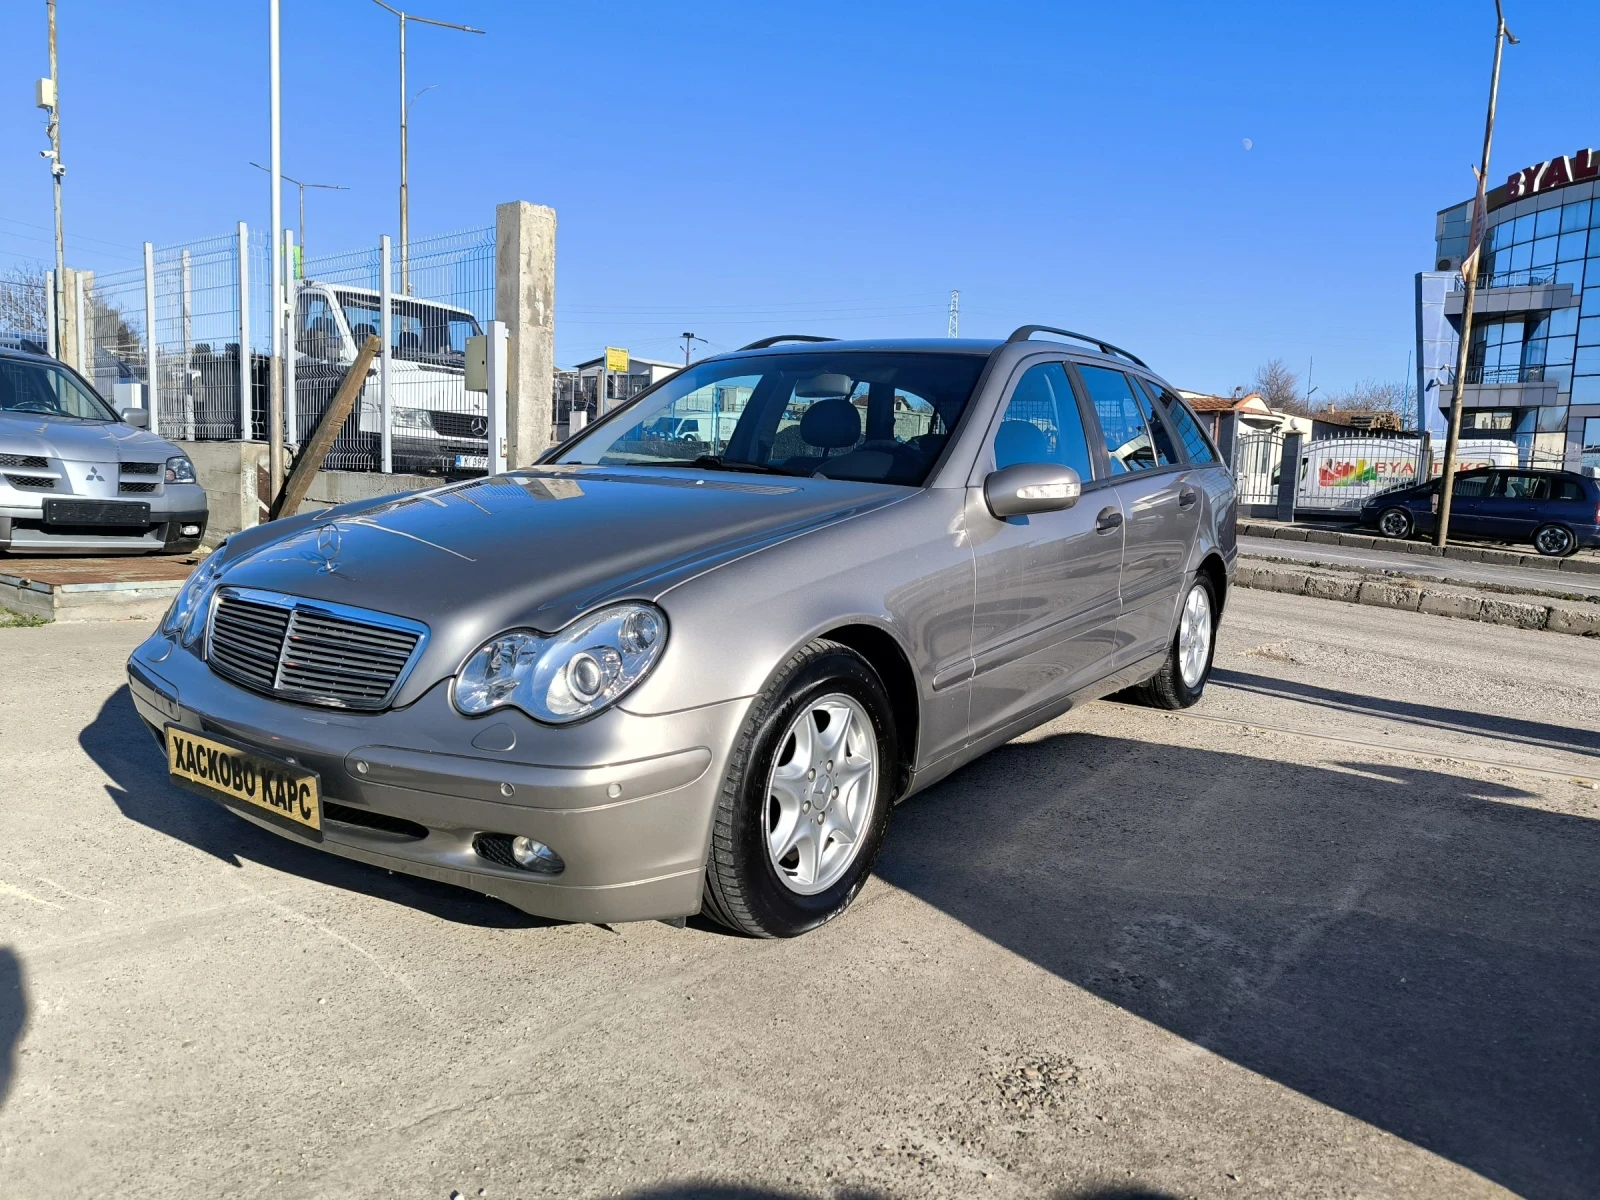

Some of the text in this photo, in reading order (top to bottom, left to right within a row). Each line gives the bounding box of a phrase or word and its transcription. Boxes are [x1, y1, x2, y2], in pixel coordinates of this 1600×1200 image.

[1506, 148, 1599, 200] BYAL
[173, 736, 311, 820] ХАСКОВО КАРС
